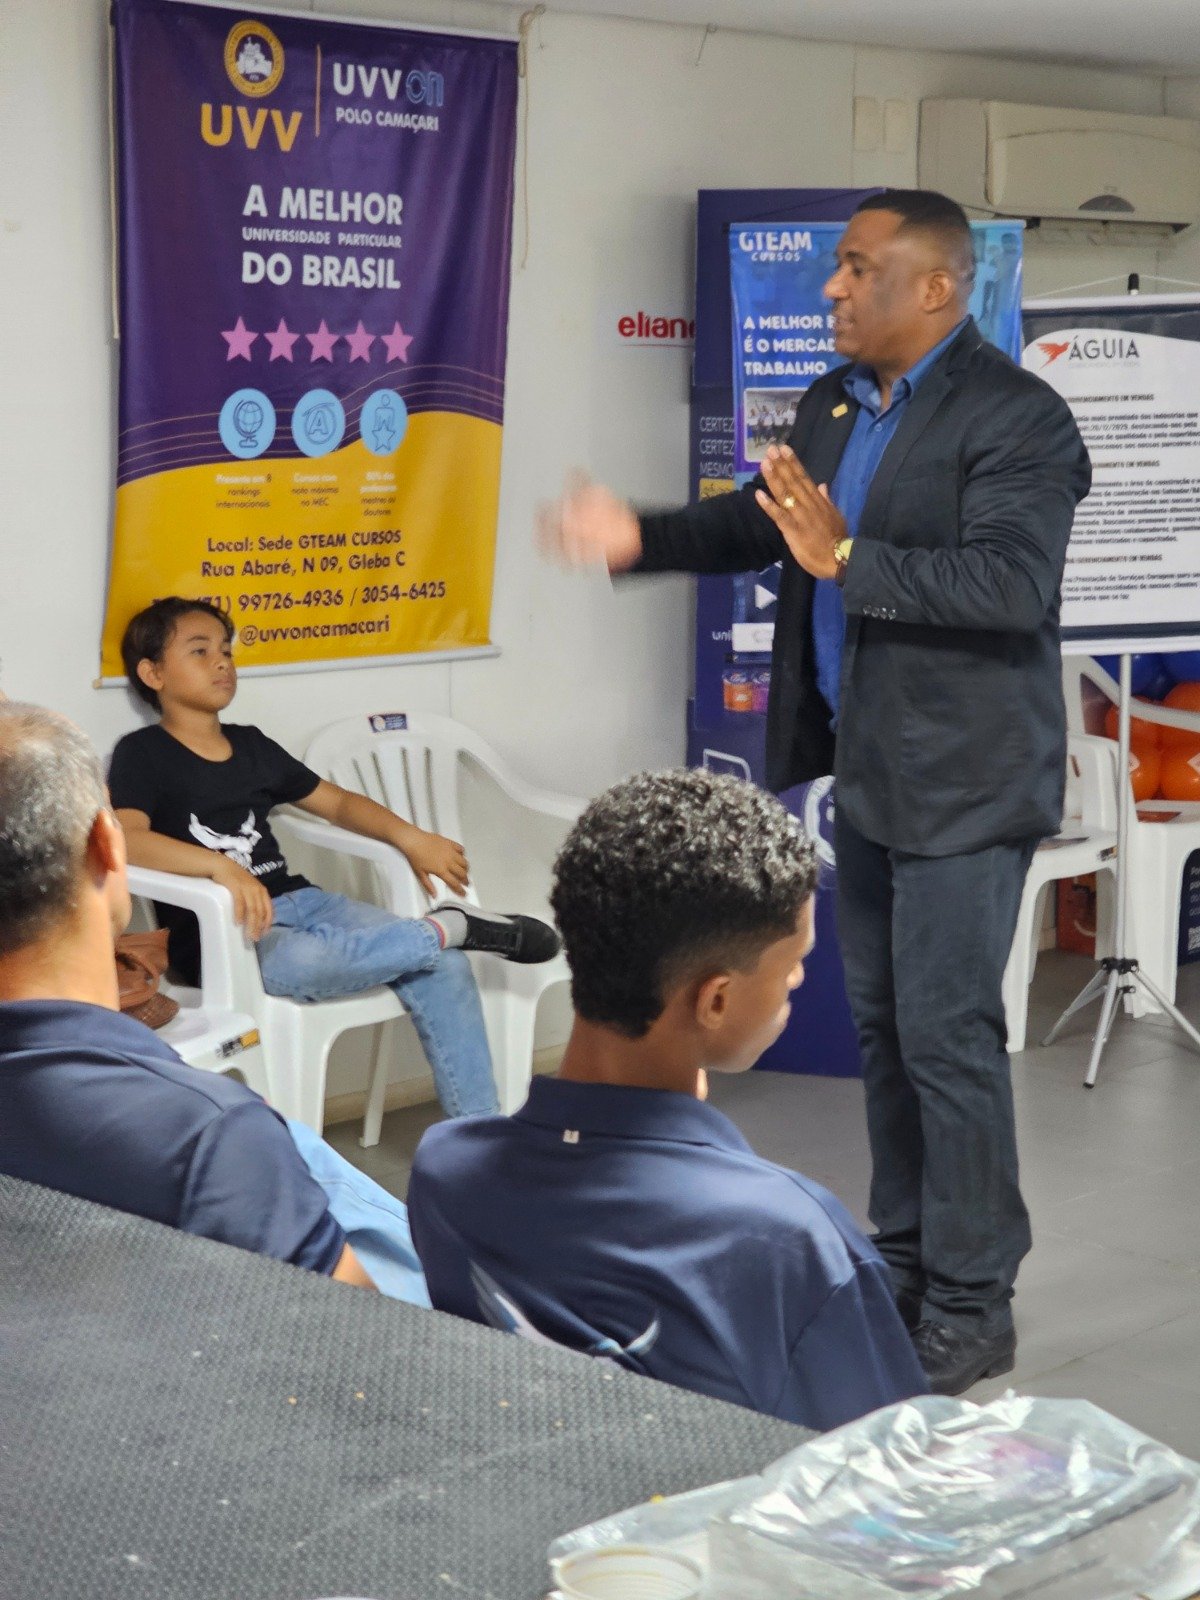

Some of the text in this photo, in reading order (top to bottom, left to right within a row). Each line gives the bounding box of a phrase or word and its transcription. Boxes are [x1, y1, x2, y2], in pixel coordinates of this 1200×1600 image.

[201, 103, 302, 152] UVV
[336, 106, 439, 133] POLO CAMAÇARI
[242, 184, 403, 225] A MELHOR
[242, 226, 402, 249] UNIVERSIDADE PARTICULAR
[738, 231, 812, 251] GTEAM
[751, 251, 801, 262] CURSOS
[242, 251, 401, 290] DO BRASIL
[743, 316, 756, 329] A
[759, 315, 824, 329] MELHOR
[744, 335, 836, 353] É O MERCAD
[1068, 335, 1140, 360] ÁGUIA
[744, 361, 827, 376] TRABALHO
[700, 416, 735, 432] CERTEZ
[700, 439, 735, 455] CERTEZ
[207, 529, 402, 553] Local: Sede GTEAM CURSOS
[201, 551, 406, 578] Rua Abaré, N 09, Gleba C
[238, 589, 344, 612] 99726-4936
[361, 581, 446, 605] 3054-6425
[239, 615, 390, 646] @uvvoncamacari
